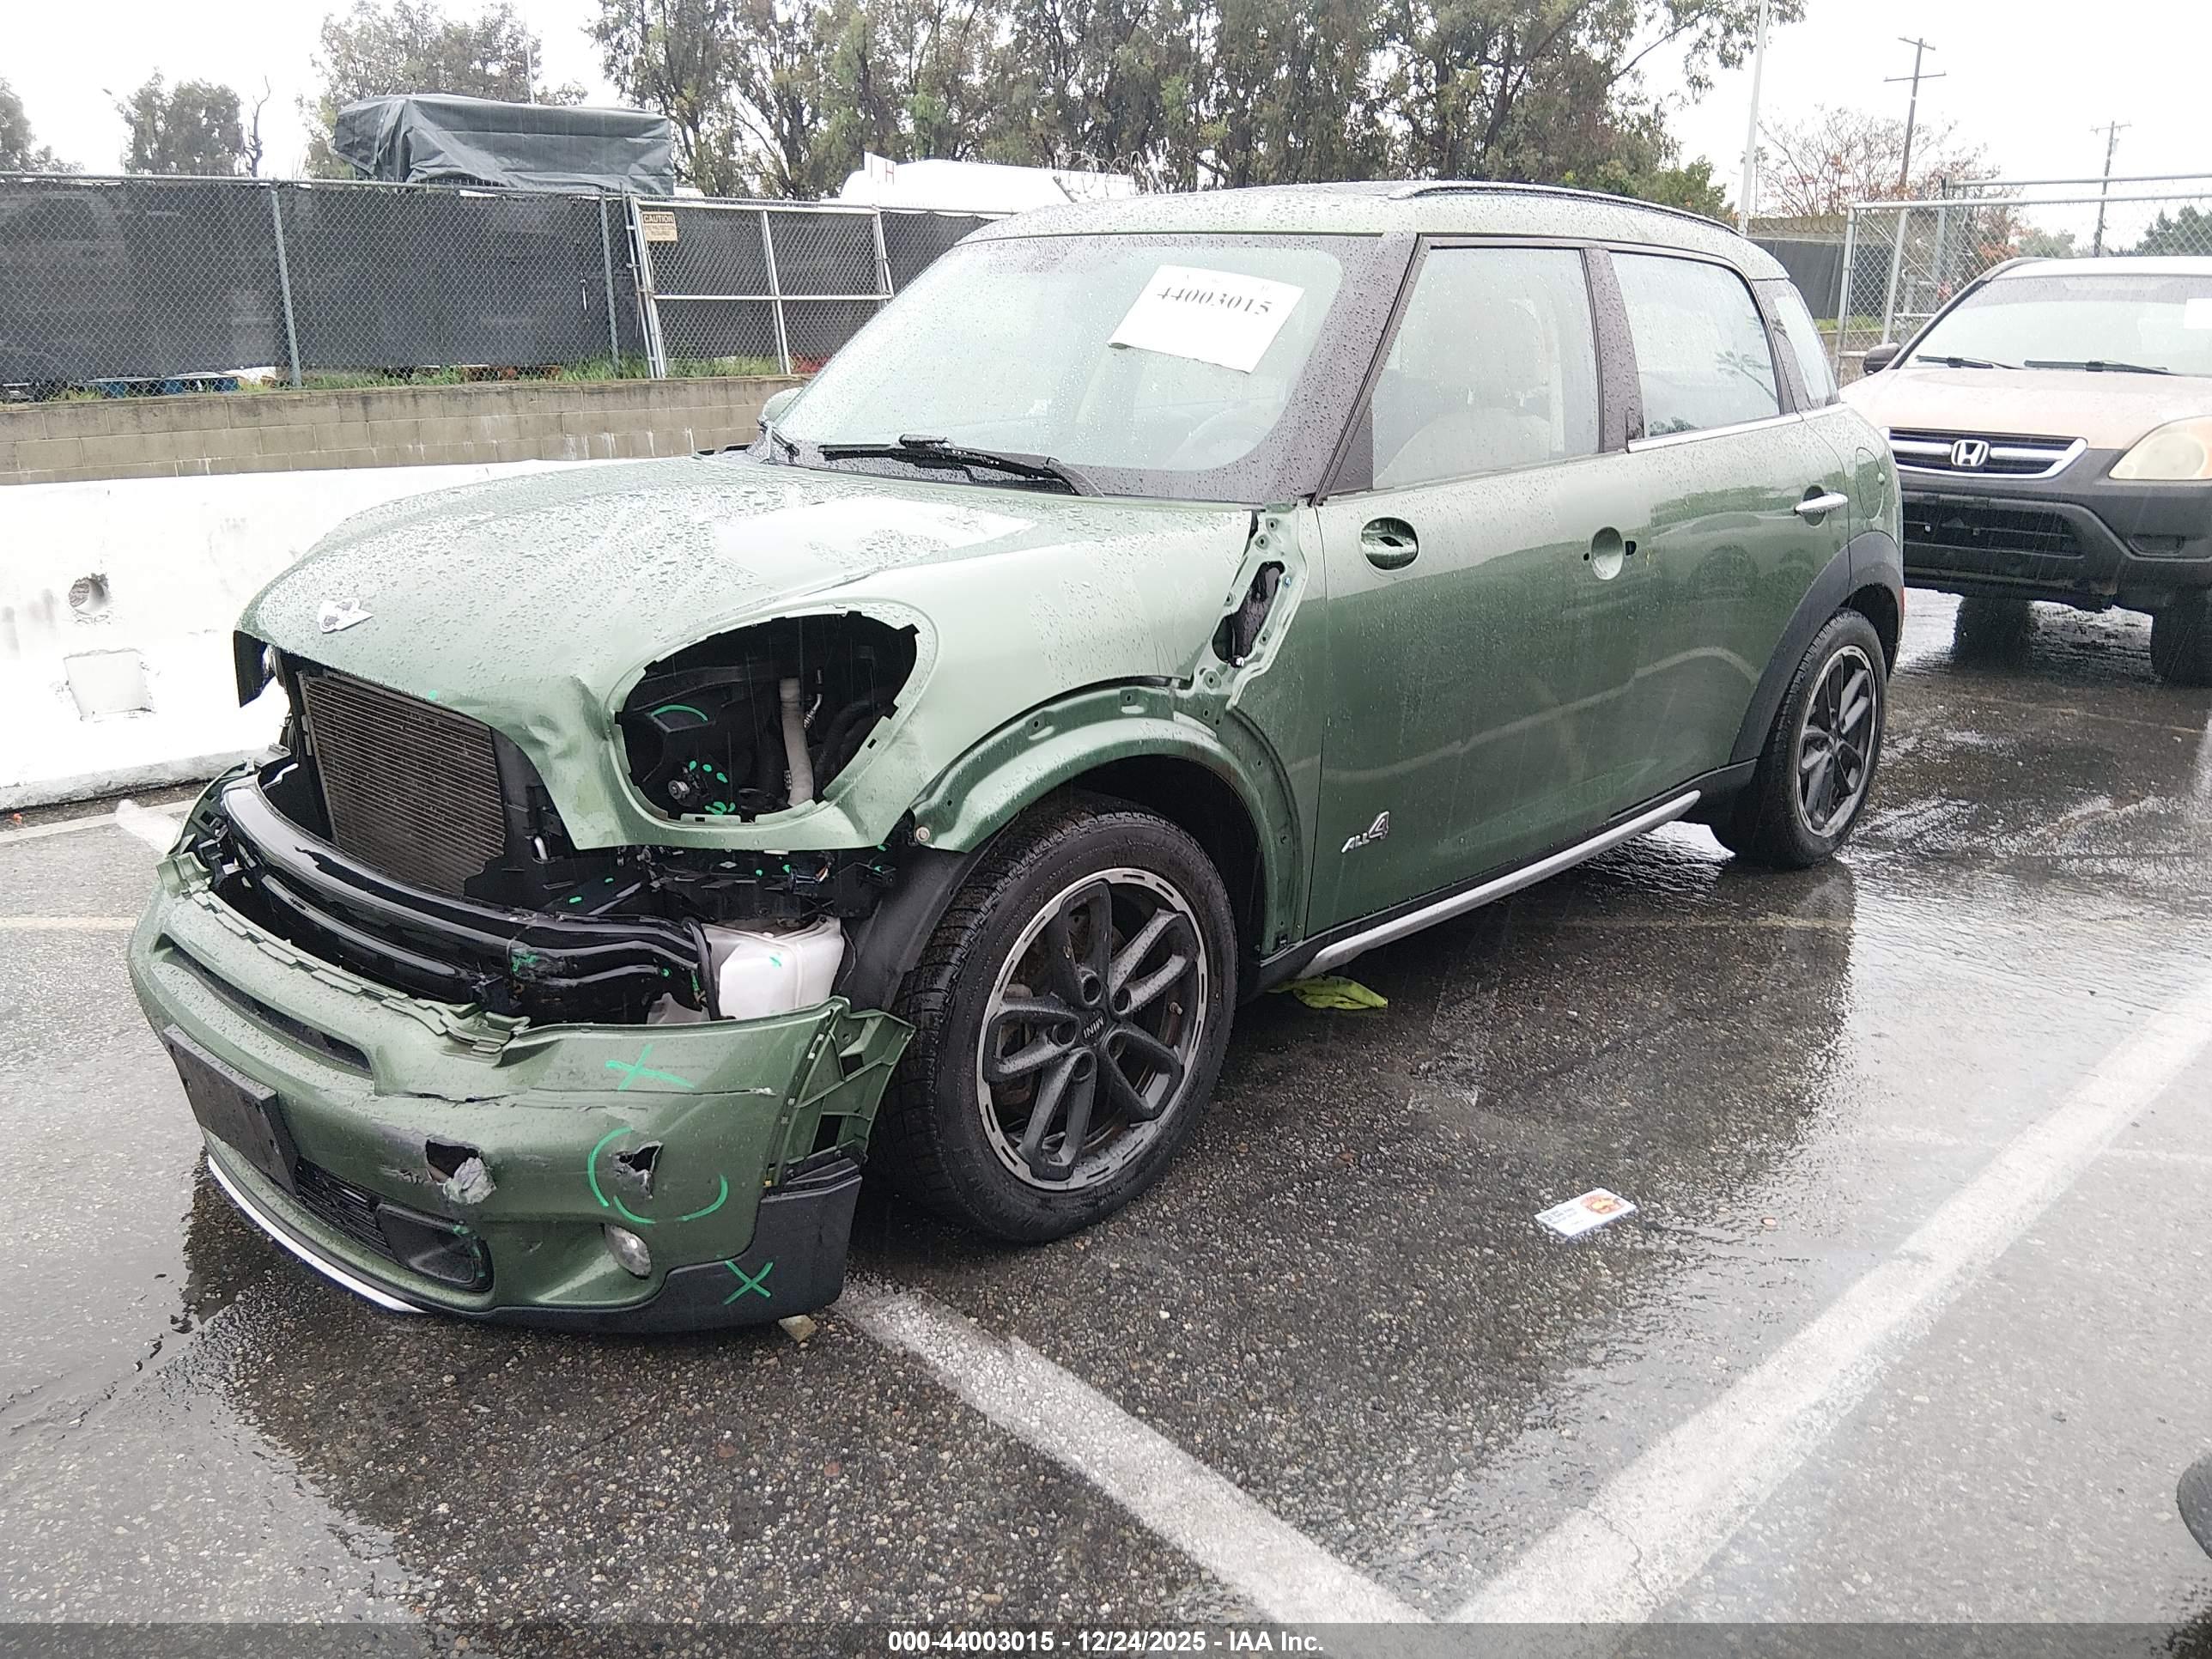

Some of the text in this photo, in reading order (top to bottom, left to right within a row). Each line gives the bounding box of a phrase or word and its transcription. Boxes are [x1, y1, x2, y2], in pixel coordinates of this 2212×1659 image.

[643, 215, 674, 223] CAUTION
[1157, 287, 1272, 315] 44003015
[1083, 1016, 1104, 1039] MINI
